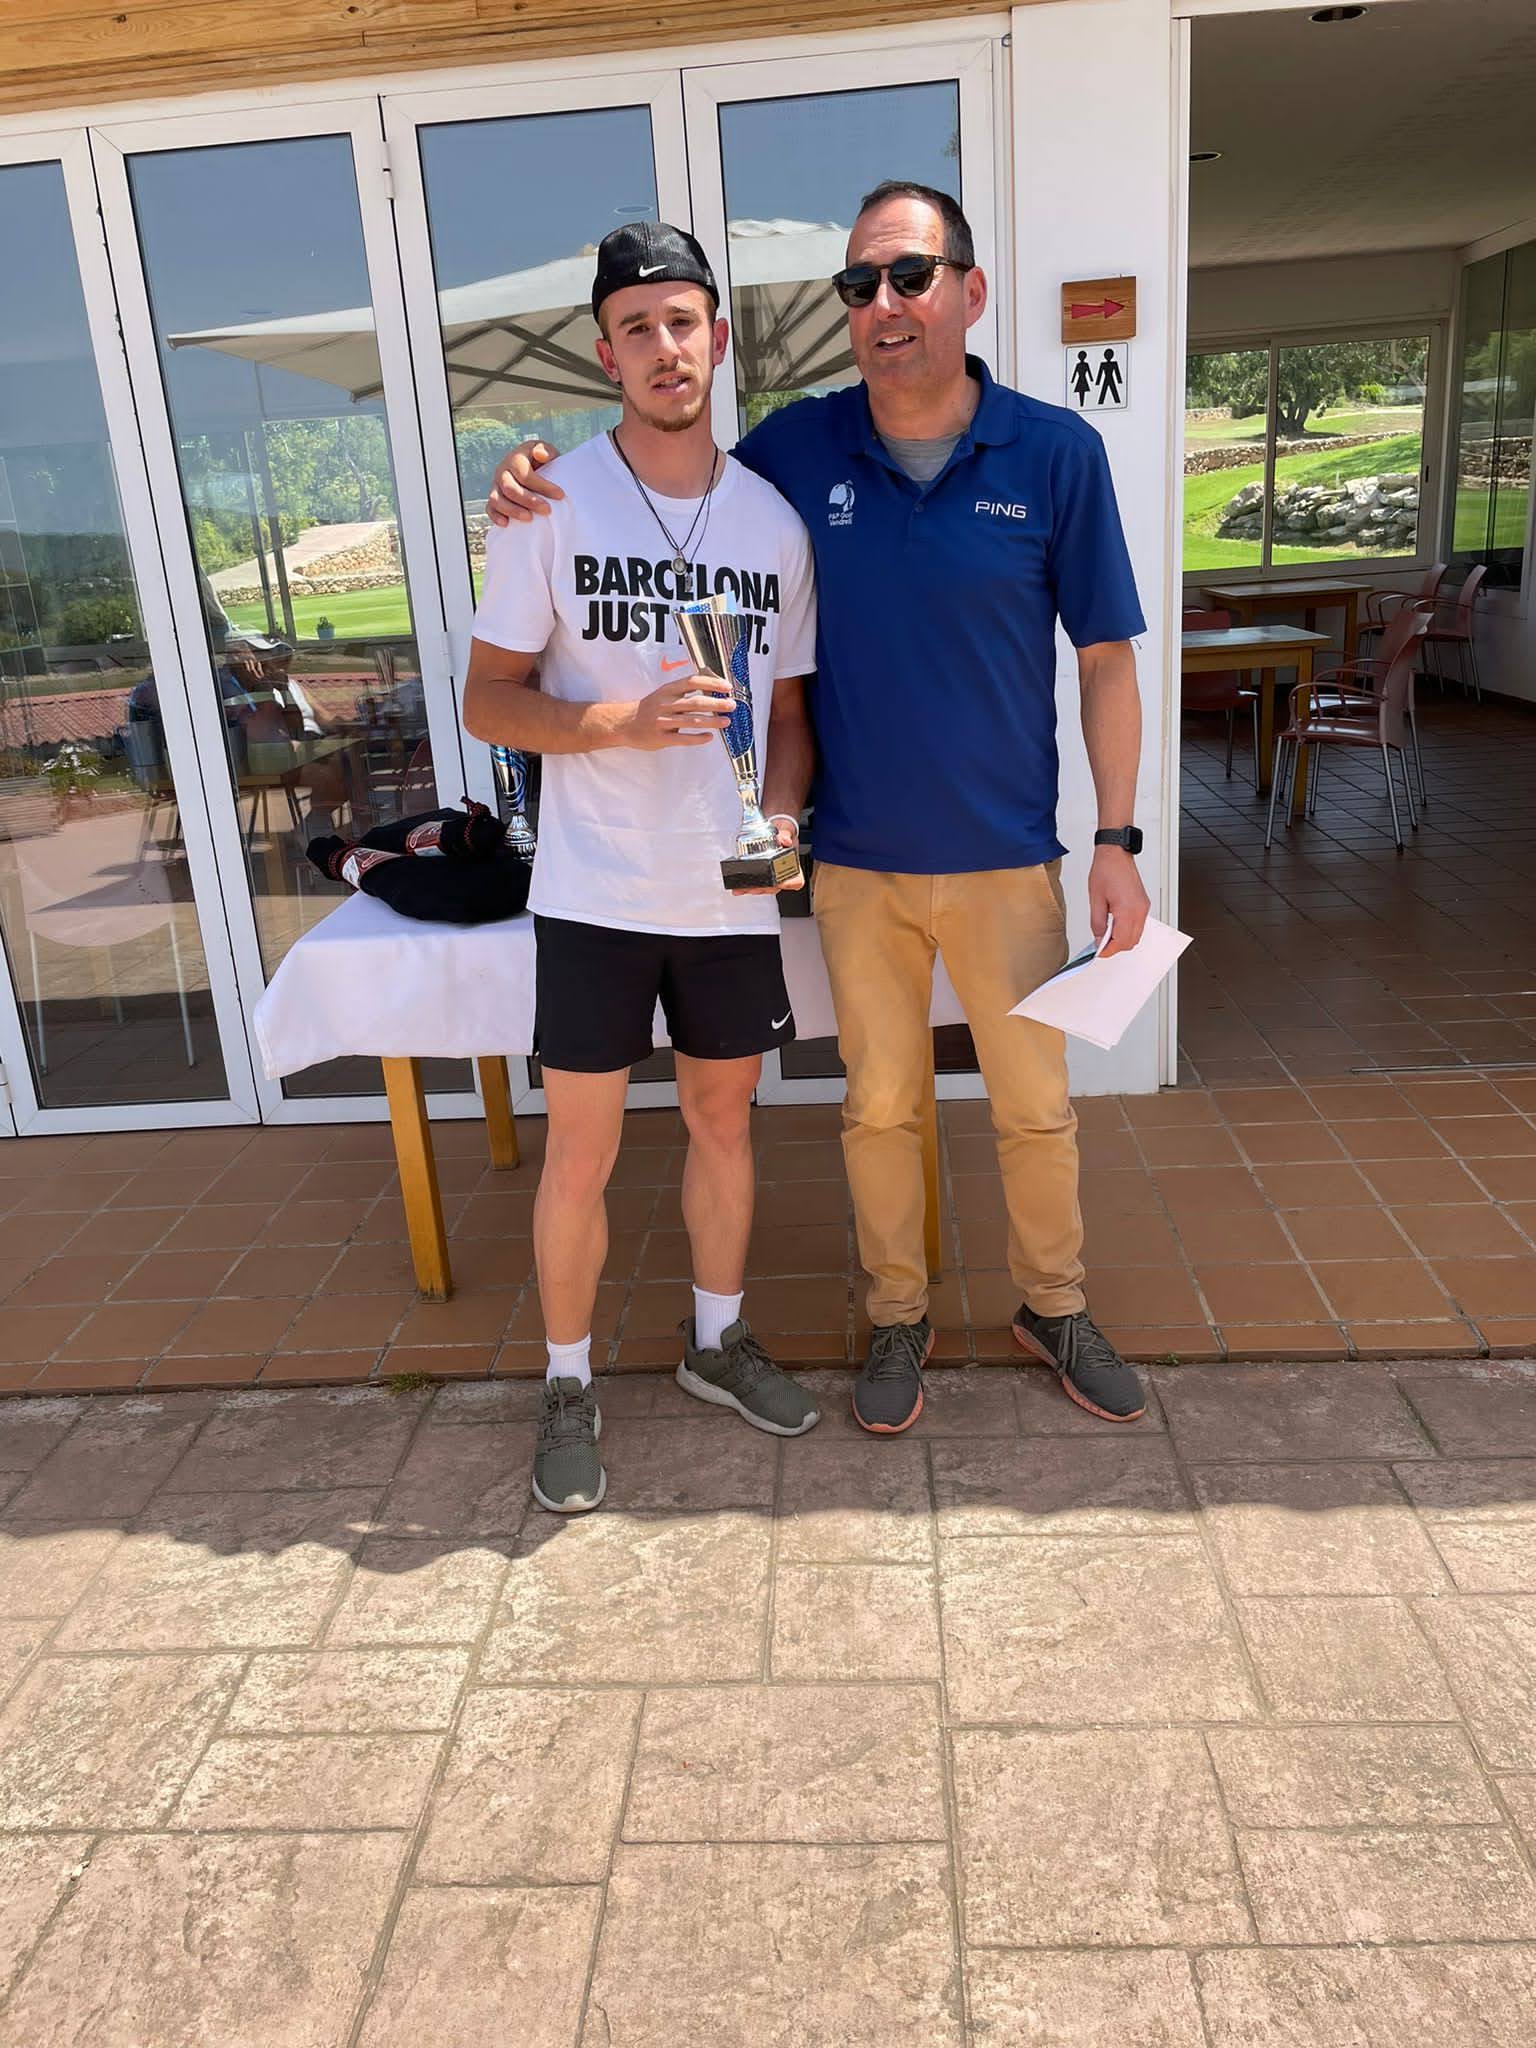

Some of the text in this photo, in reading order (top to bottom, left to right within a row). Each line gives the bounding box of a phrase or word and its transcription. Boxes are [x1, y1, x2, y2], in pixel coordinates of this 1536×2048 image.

[975, 501, 1027, 519] PING
[574, 555, 780, 613] BARCELONA
[582, 601, 670, 642] JUST
